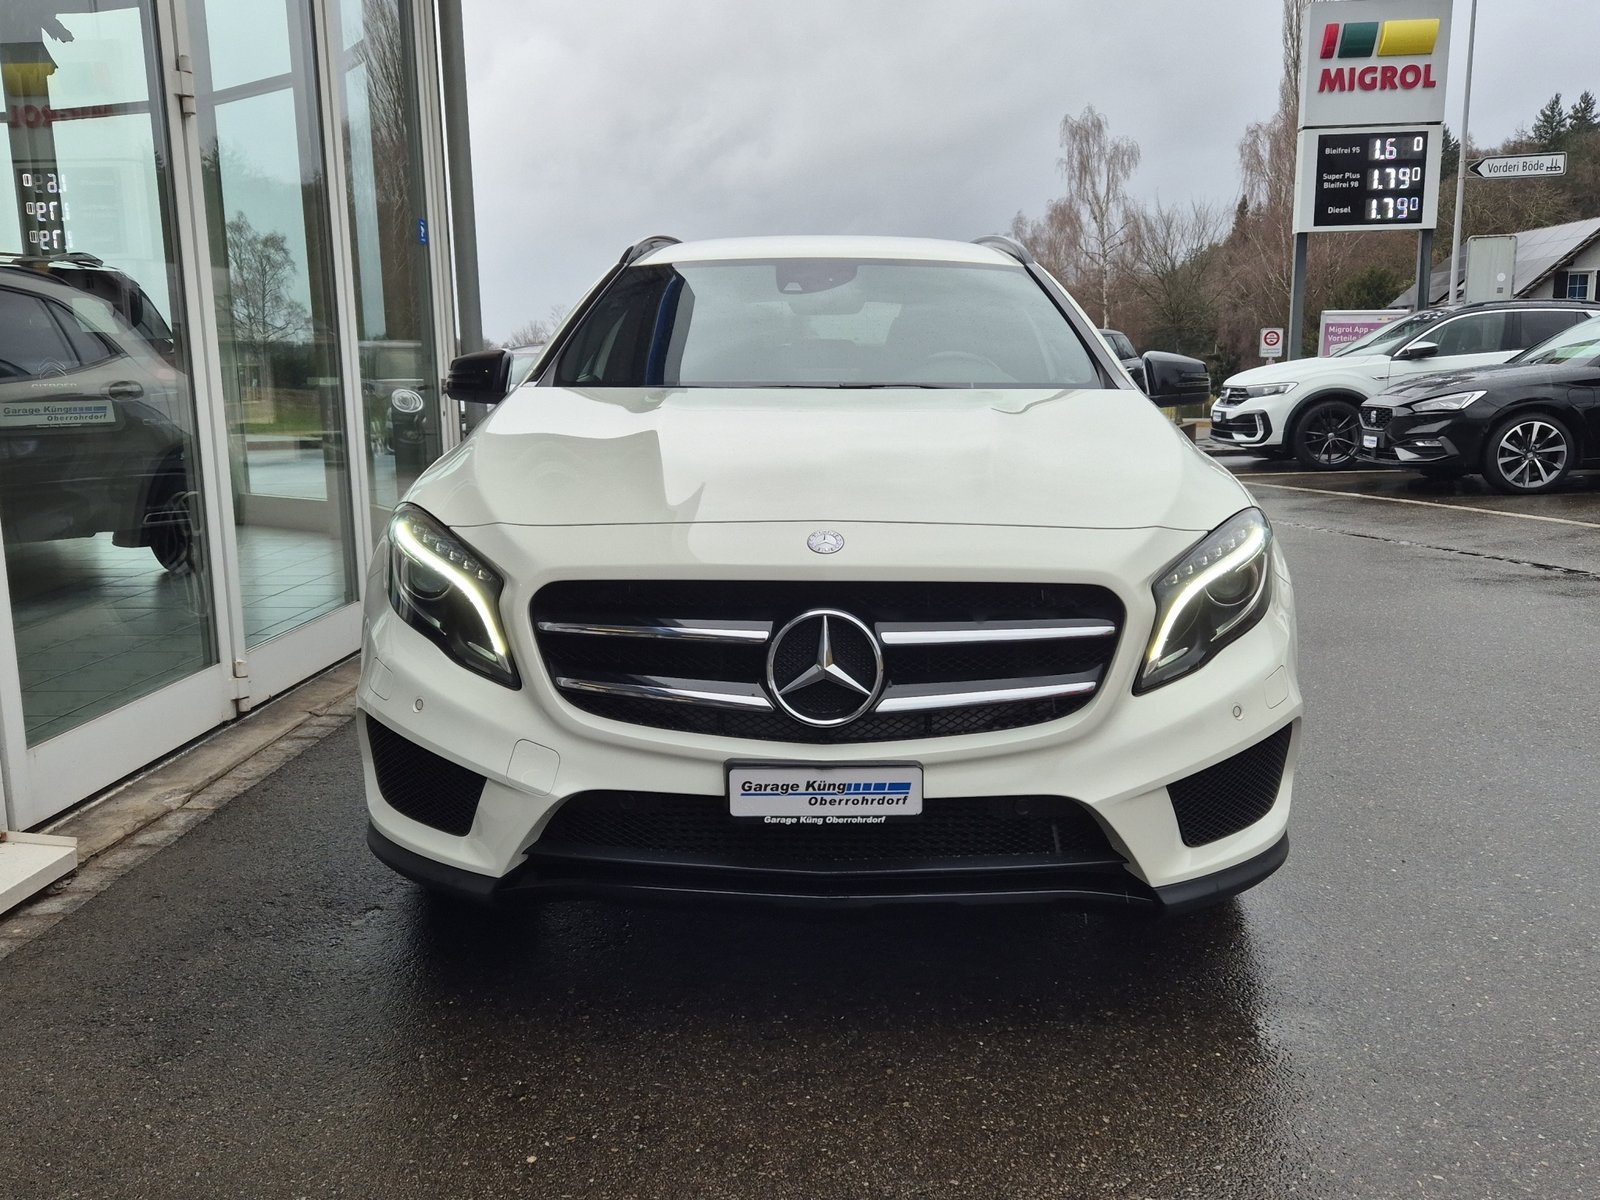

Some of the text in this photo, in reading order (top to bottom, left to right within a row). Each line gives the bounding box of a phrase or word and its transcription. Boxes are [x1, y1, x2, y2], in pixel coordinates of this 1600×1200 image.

[1318, 64, 1436, 93] MIGROL
[1325, 146, 1360, 155] Bleifrei 95
[1488, 160, 1544, 173] Vorderi Böde
[1323, 173, 1343, 181] Super
[1323, 181, 1349, 189] Bleifrei
[1327, 206, 1351, 214] Diesel
[1328, 326, 1352, 334] Migrol
[1354, 326, 1369, 334] App
[3, 406, 69, 415] Garage Küng
[47, 414, 107, 422] Oberrohrdorf
[741, 780, 847, 795] Garage Küng
[808, 795, 909, 807] Oberrohrdorf
[764, 816, 886, 825] Garage Küng Oberrohrdorf
